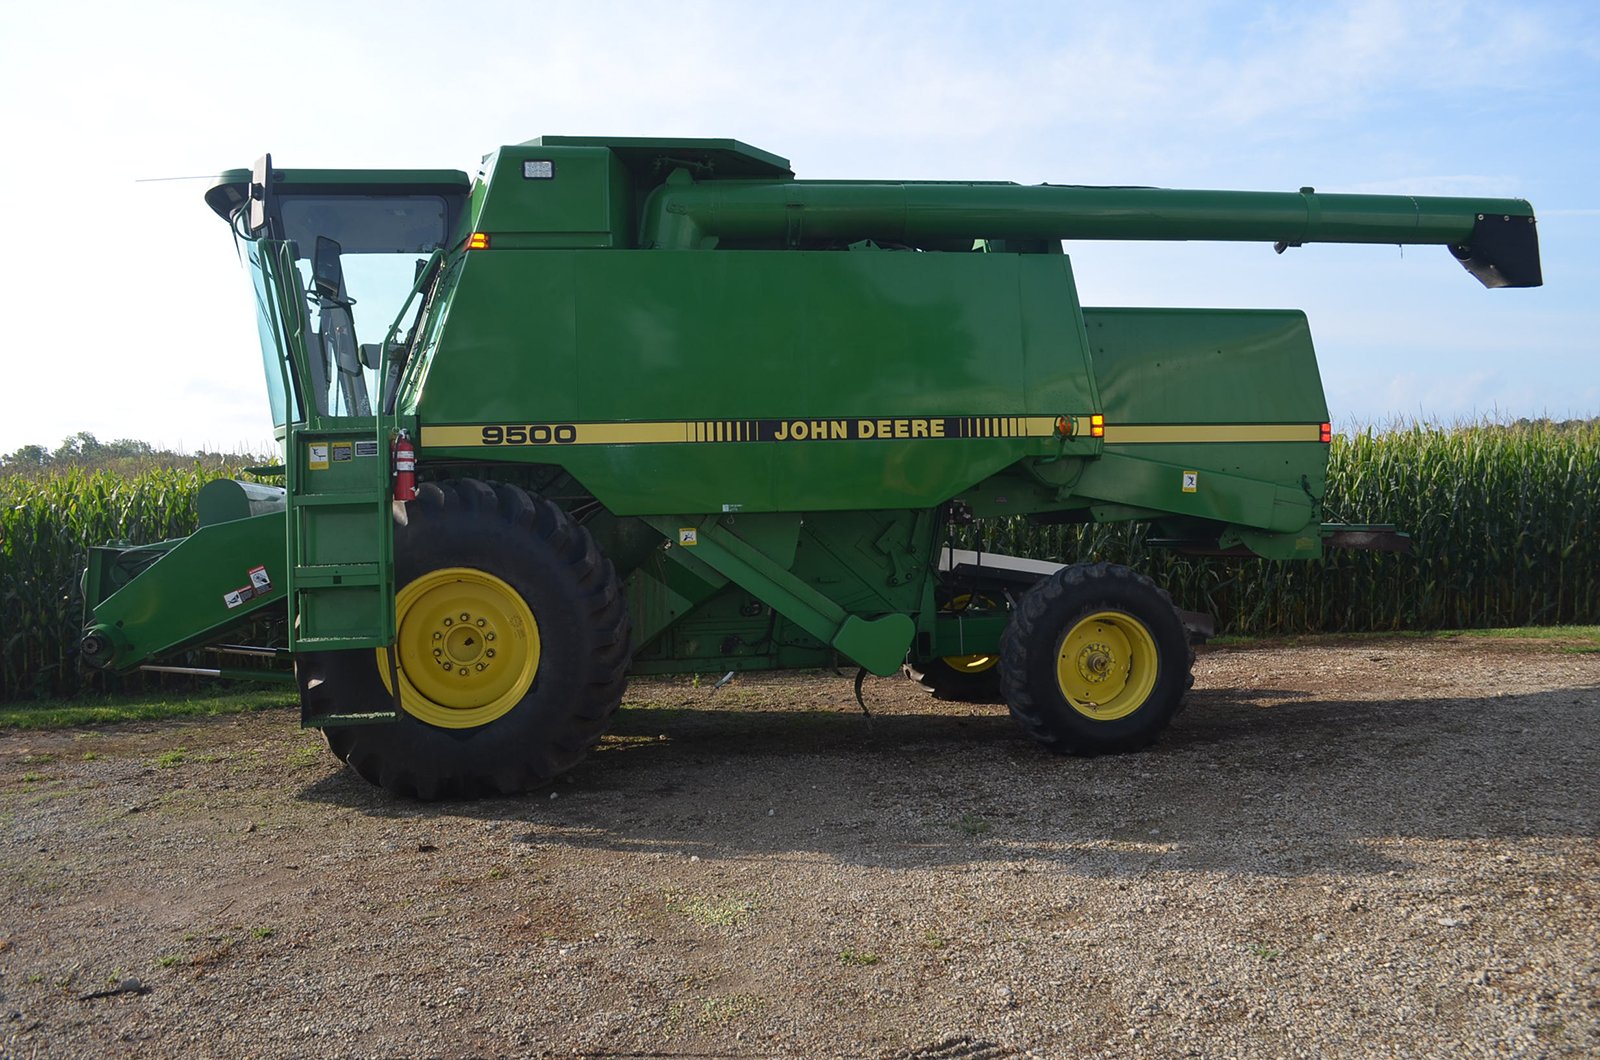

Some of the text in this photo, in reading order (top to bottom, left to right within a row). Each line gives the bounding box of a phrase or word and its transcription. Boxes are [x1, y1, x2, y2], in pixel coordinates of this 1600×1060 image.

[482, 425, 577, 445] 9500
[774, 419, 945, 440] JOHN DEERE
